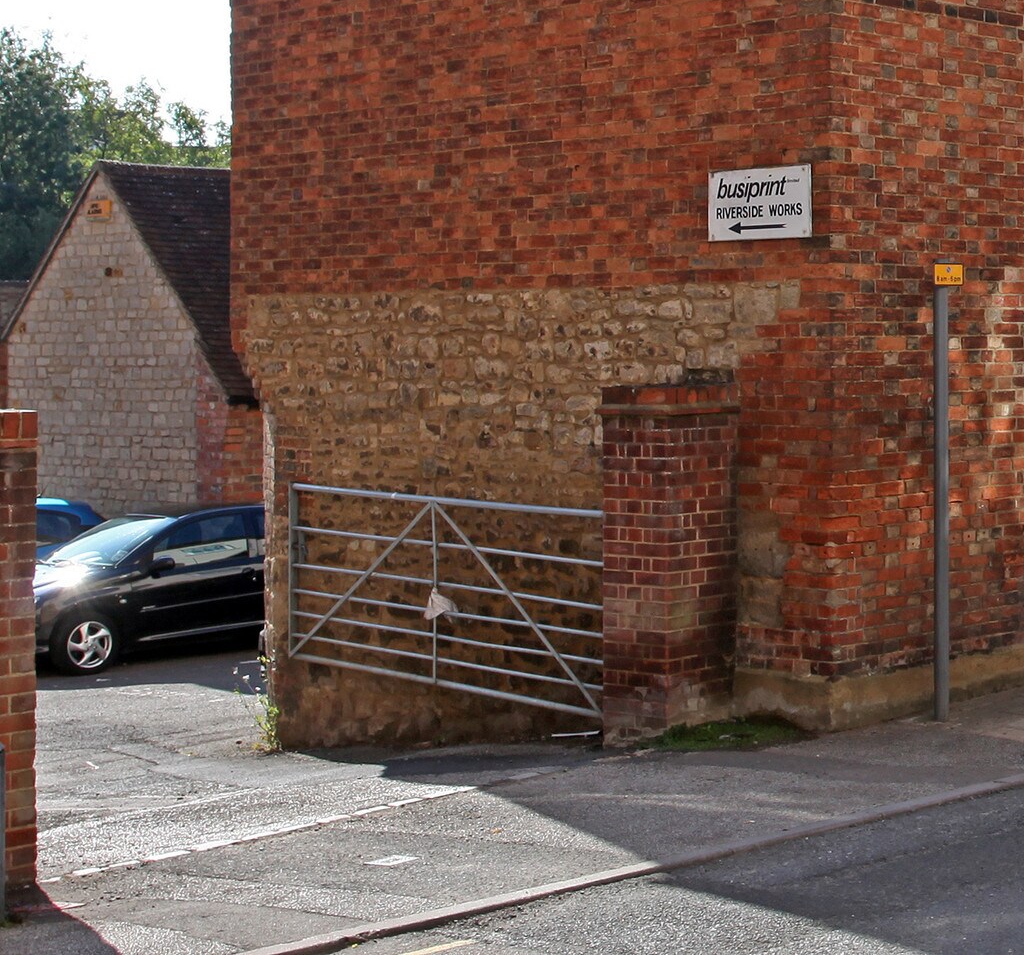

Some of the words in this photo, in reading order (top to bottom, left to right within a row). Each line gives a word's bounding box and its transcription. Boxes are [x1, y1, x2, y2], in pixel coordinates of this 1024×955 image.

[717, 175, 787, 203] busiprint
[716, 205, 763, 219] RIVERSIDE
[769, 203, 803, 216] WORKS
